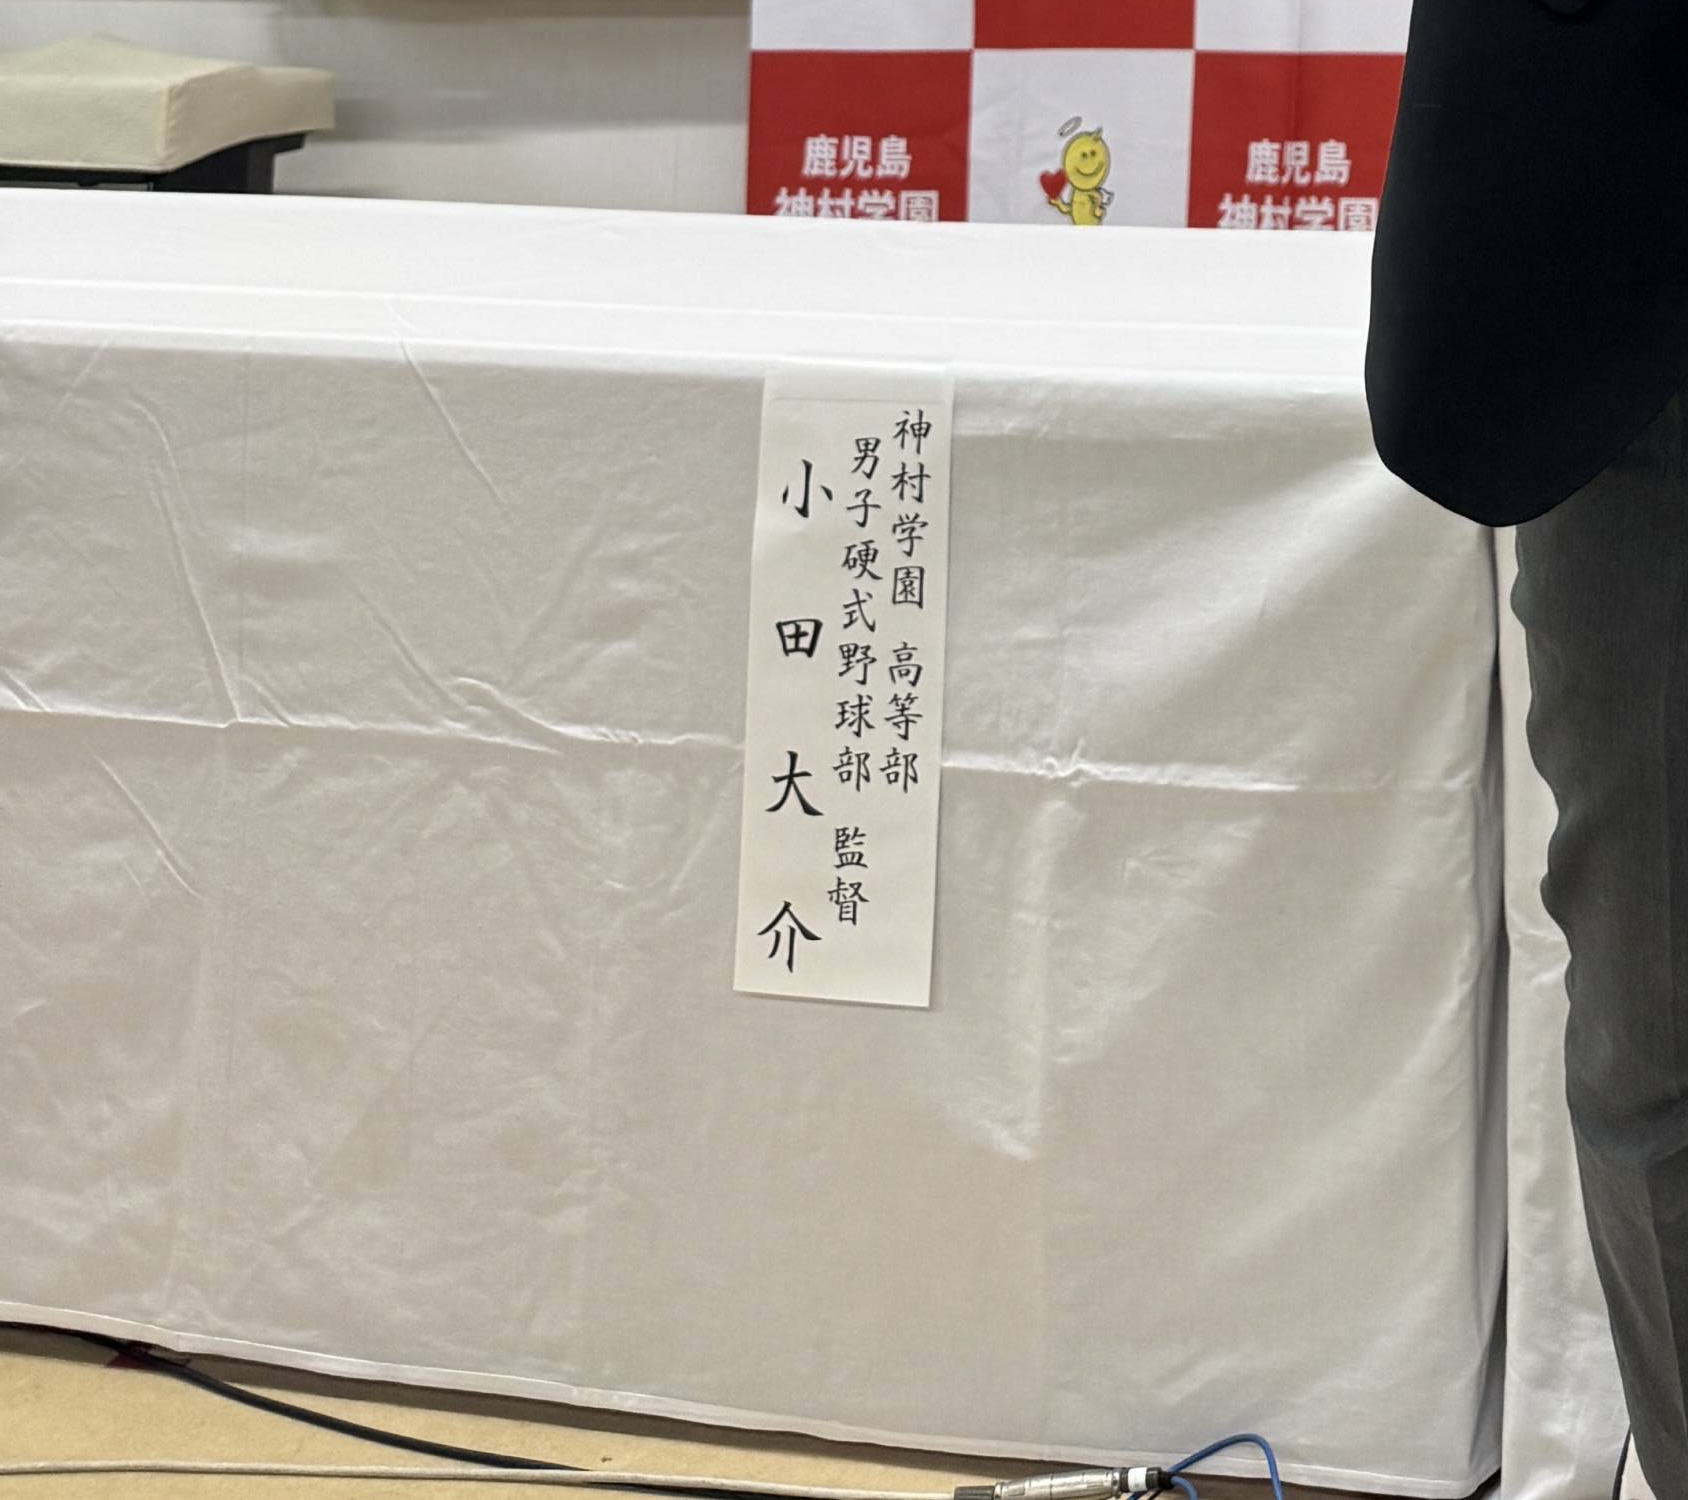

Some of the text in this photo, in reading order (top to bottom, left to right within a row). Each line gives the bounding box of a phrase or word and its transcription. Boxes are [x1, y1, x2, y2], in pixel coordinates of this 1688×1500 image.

[802, 134, 912, 180] 鹿児島
[1246, 138, 1351, 186] 鹿児島
[757, 459, 833, 973] 小田大介
[827, 435, 882, 926] 男子硬式野球部 監督
[880, 409, 932, 794] 神村学園 高等部
